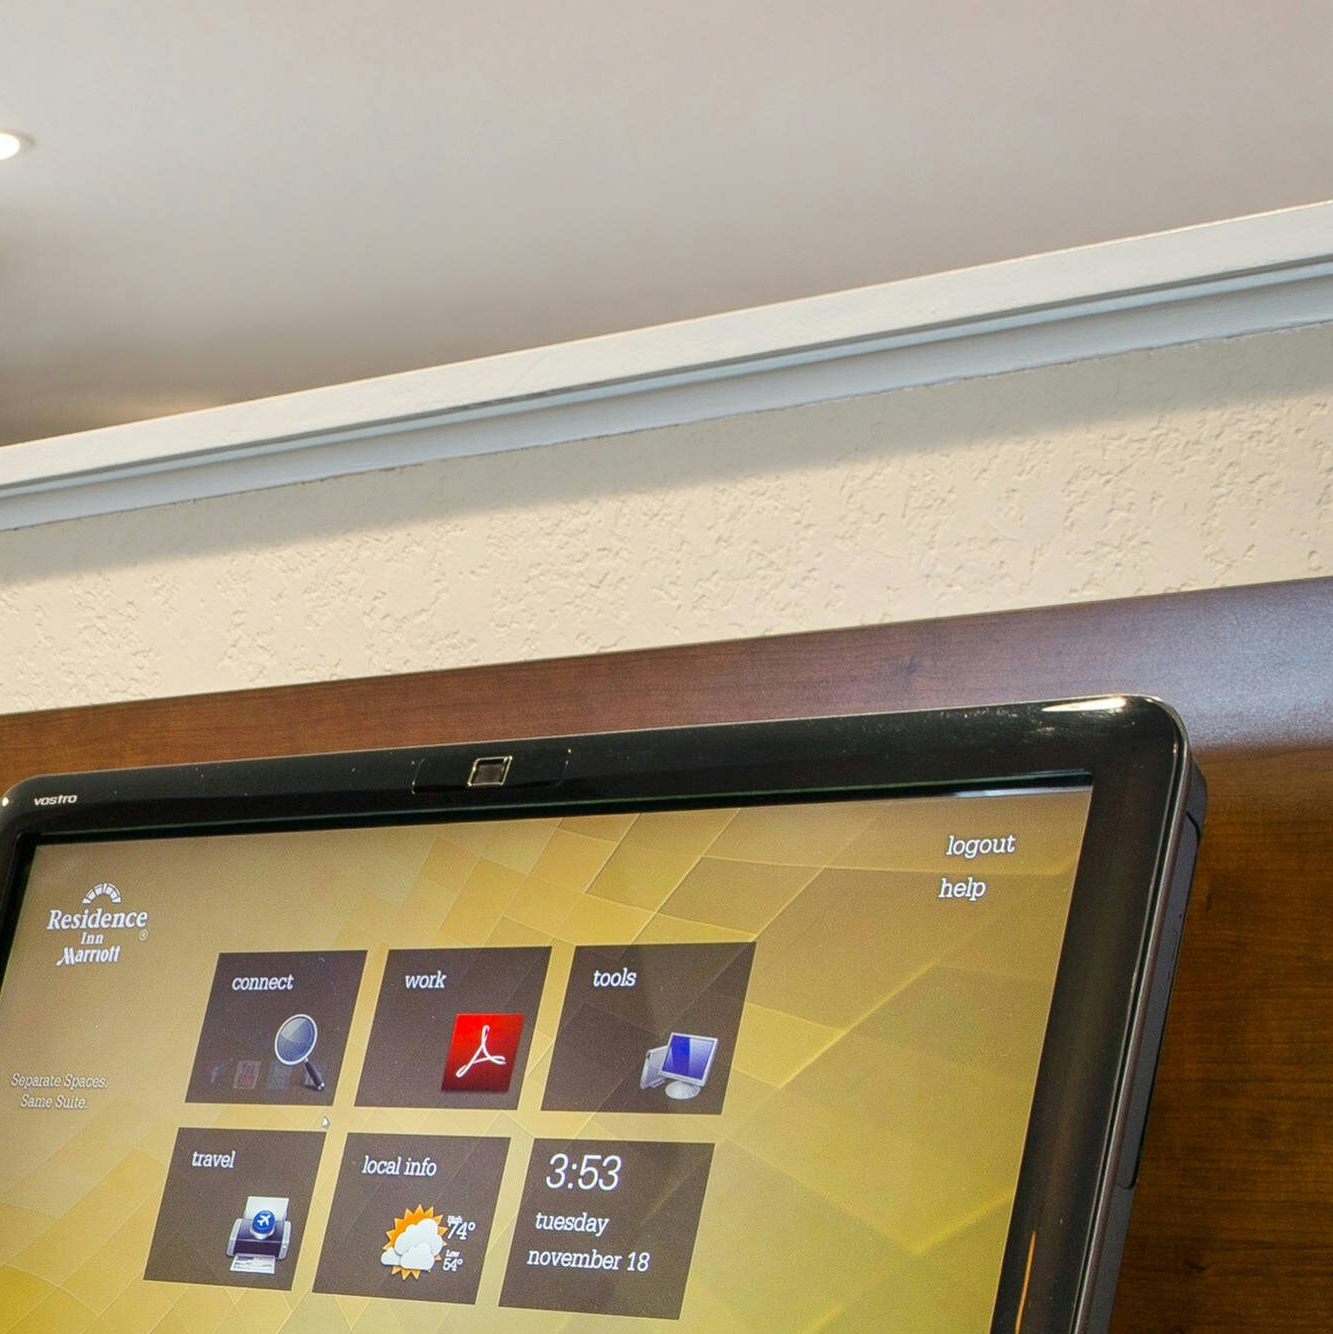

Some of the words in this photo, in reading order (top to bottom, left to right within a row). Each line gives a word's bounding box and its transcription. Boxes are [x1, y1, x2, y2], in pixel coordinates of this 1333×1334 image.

[33, 794, 78, 806] vostro
[945, 834, 1017, 859] logout
[938, 876, 987, 901] help
[46, 908, 149, 930] Residence
[80, 931, 104, 945] Inn
[55, 945, 121, 966] Marriott
[232, 973, 295, 991] connect
[404, 969, 447, 989] work
[593, 966, 638, 987] tools
[11, 1072, 62, 1089] Separate
[20, 1093, 53, 1108] Same
[191, 1150, 237, 1169] travel
[361, 1155, 401, 1175] local
[404, 1157, 437, 1177] info
[545, 1153, 622, 1191] 3:53
[535, 1212, 610, 1237] tuesday
[526, 1248, 623, 1271] november
[627, 1251, 651, 1272] 18
